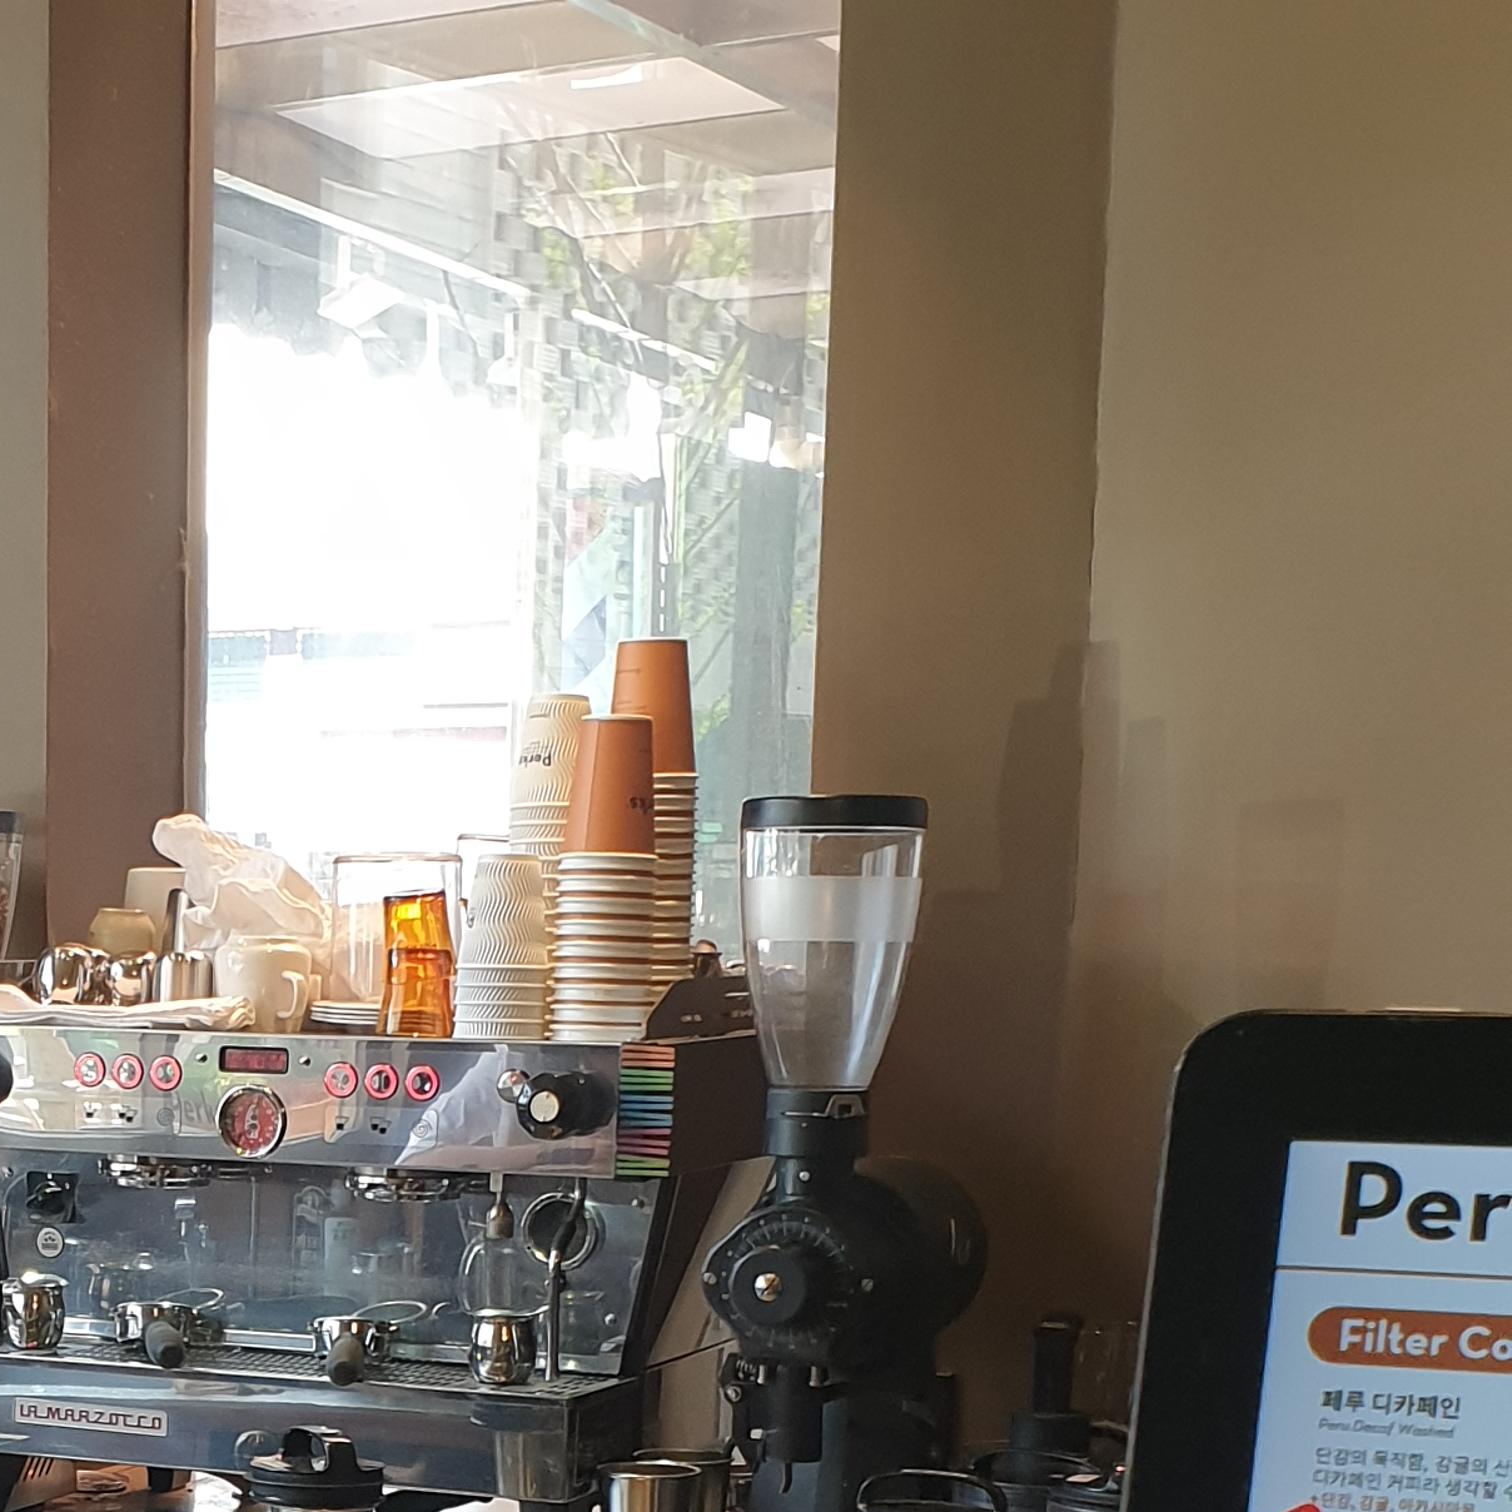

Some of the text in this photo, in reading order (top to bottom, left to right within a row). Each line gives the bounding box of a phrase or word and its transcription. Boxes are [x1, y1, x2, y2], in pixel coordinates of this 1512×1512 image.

[1339, 1318, 1448, 1357] Filter
[1321, 1390, 1461, 1420] 페루 디카페인
